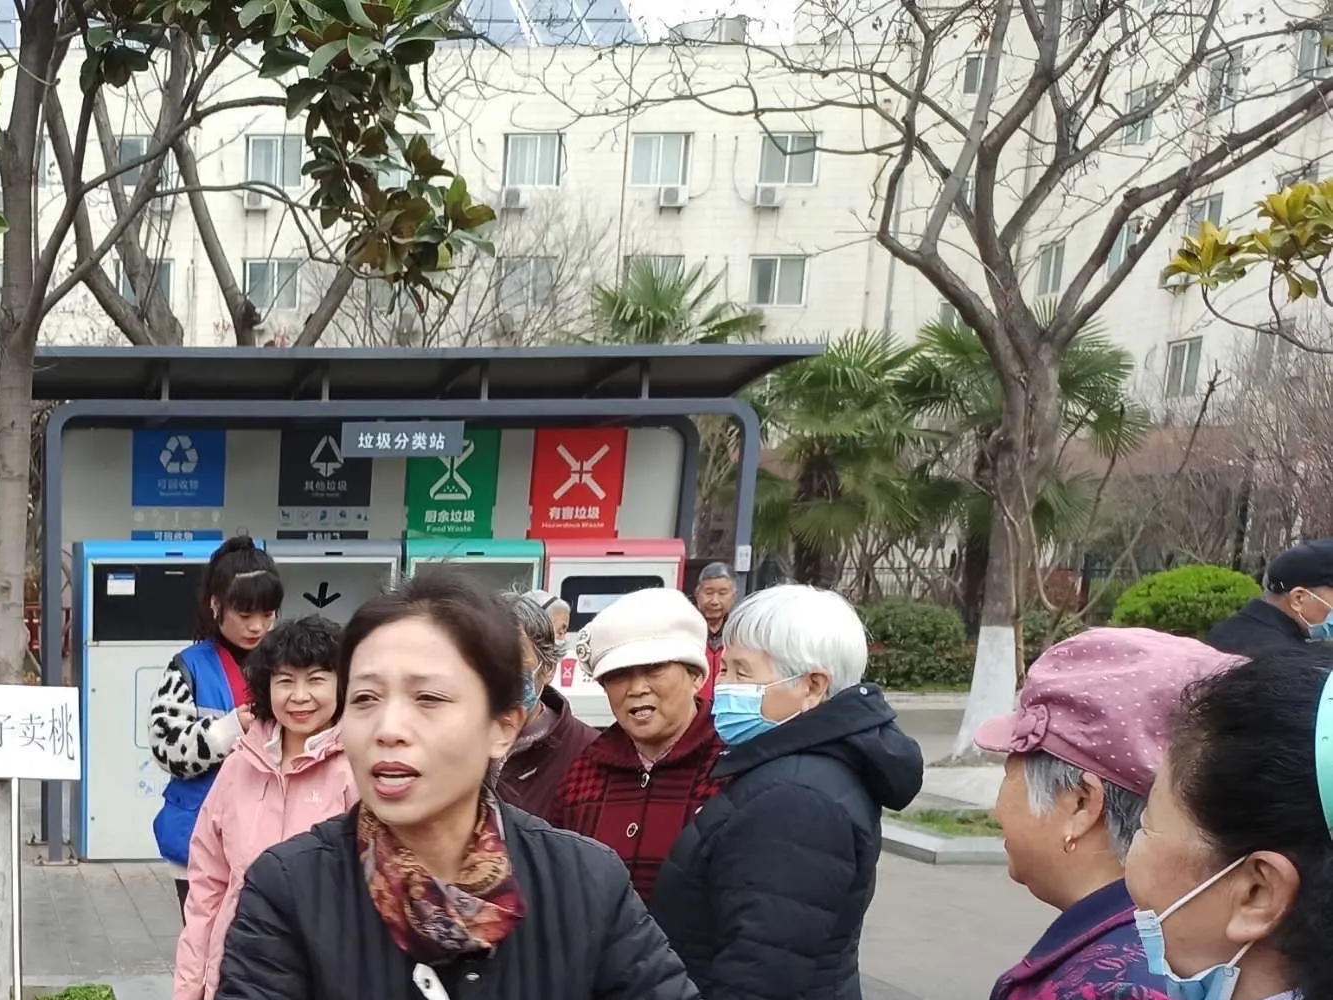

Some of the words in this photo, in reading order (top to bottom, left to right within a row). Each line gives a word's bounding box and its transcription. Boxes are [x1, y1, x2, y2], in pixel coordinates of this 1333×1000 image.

[357, 431, 446, 450] 垃圾分类站
[424, 509, 475, 523] 厨余垃圾
[549, 505, 600, 520] 有害垃圾
